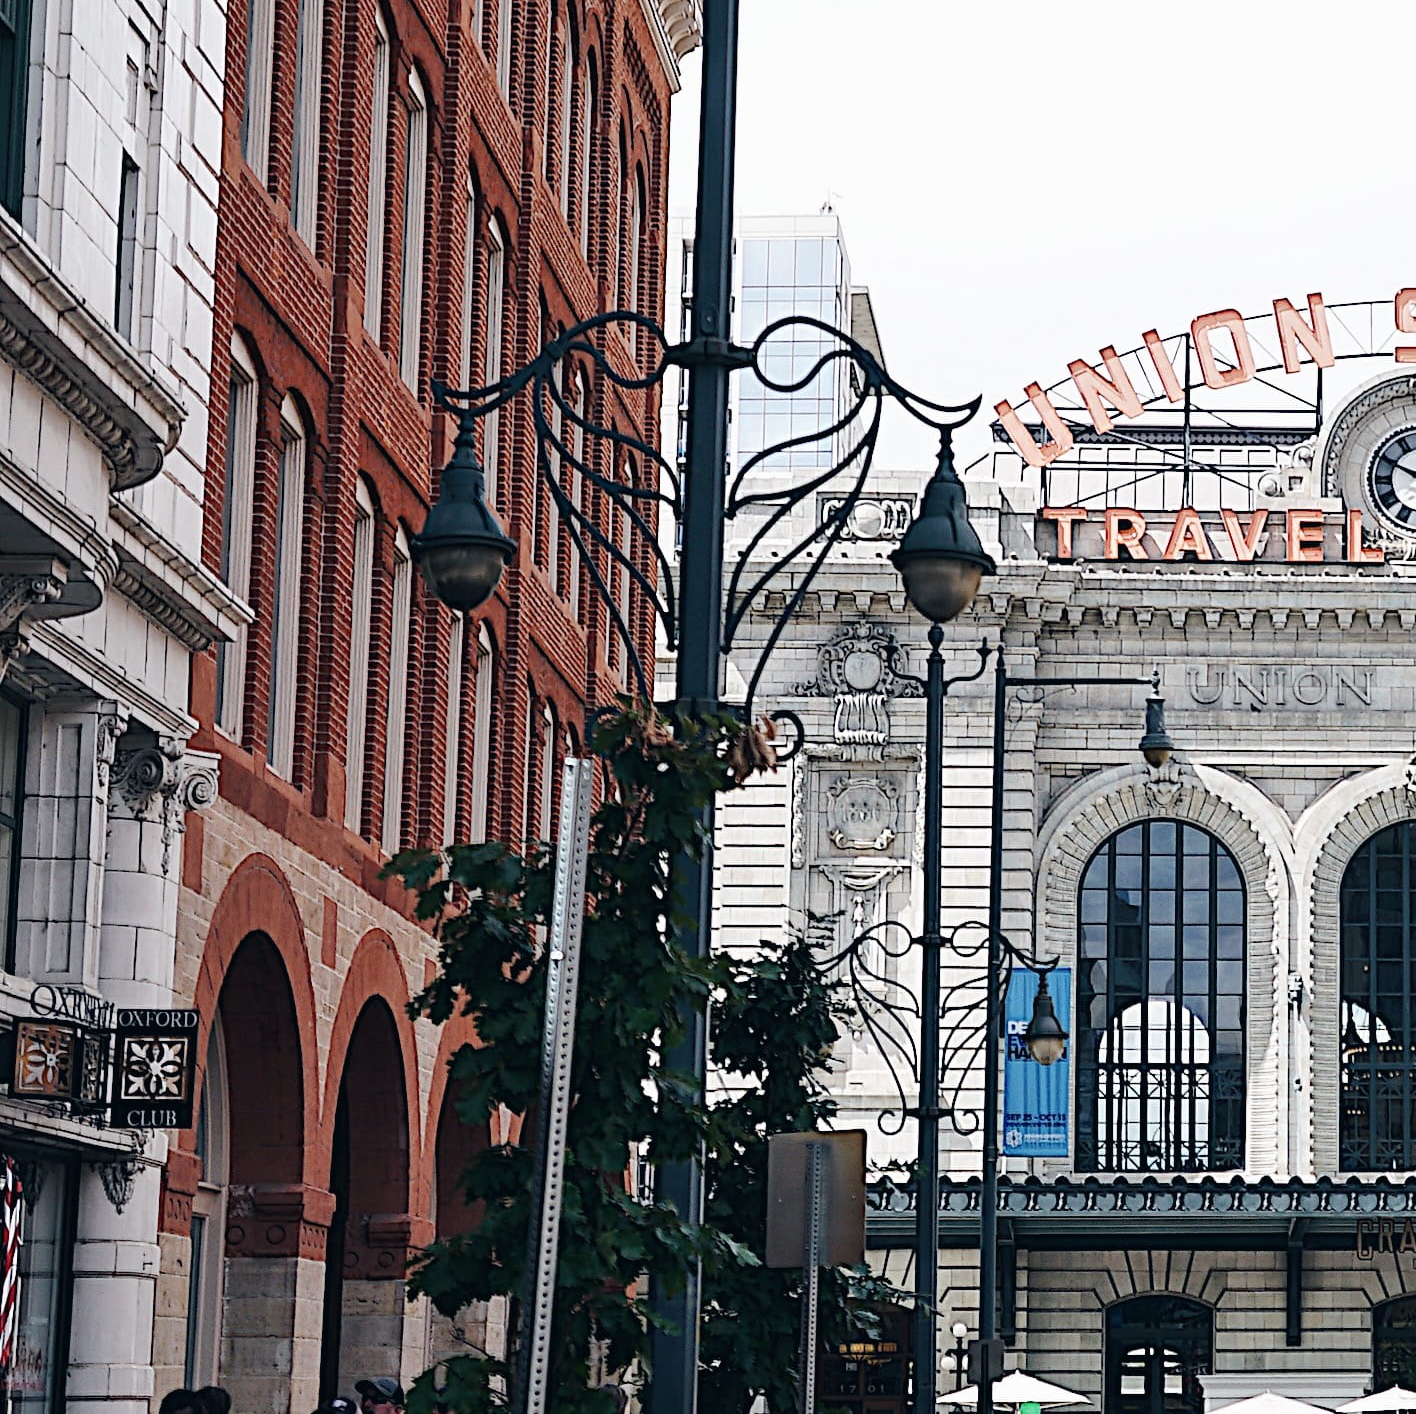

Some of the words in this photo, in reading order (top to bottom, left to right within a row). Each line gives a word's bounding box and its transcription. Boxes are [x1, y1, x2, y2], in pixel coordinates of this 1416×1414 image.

[993, 292, 1335, 468] UNION
[1042, 505, 1384, 563] TRAVEL
[1186, 669, 1373, 707] UNION
[118, 1010, 198, 1028] OXFORD
[127, 1110, 177, 1127] CLUB
